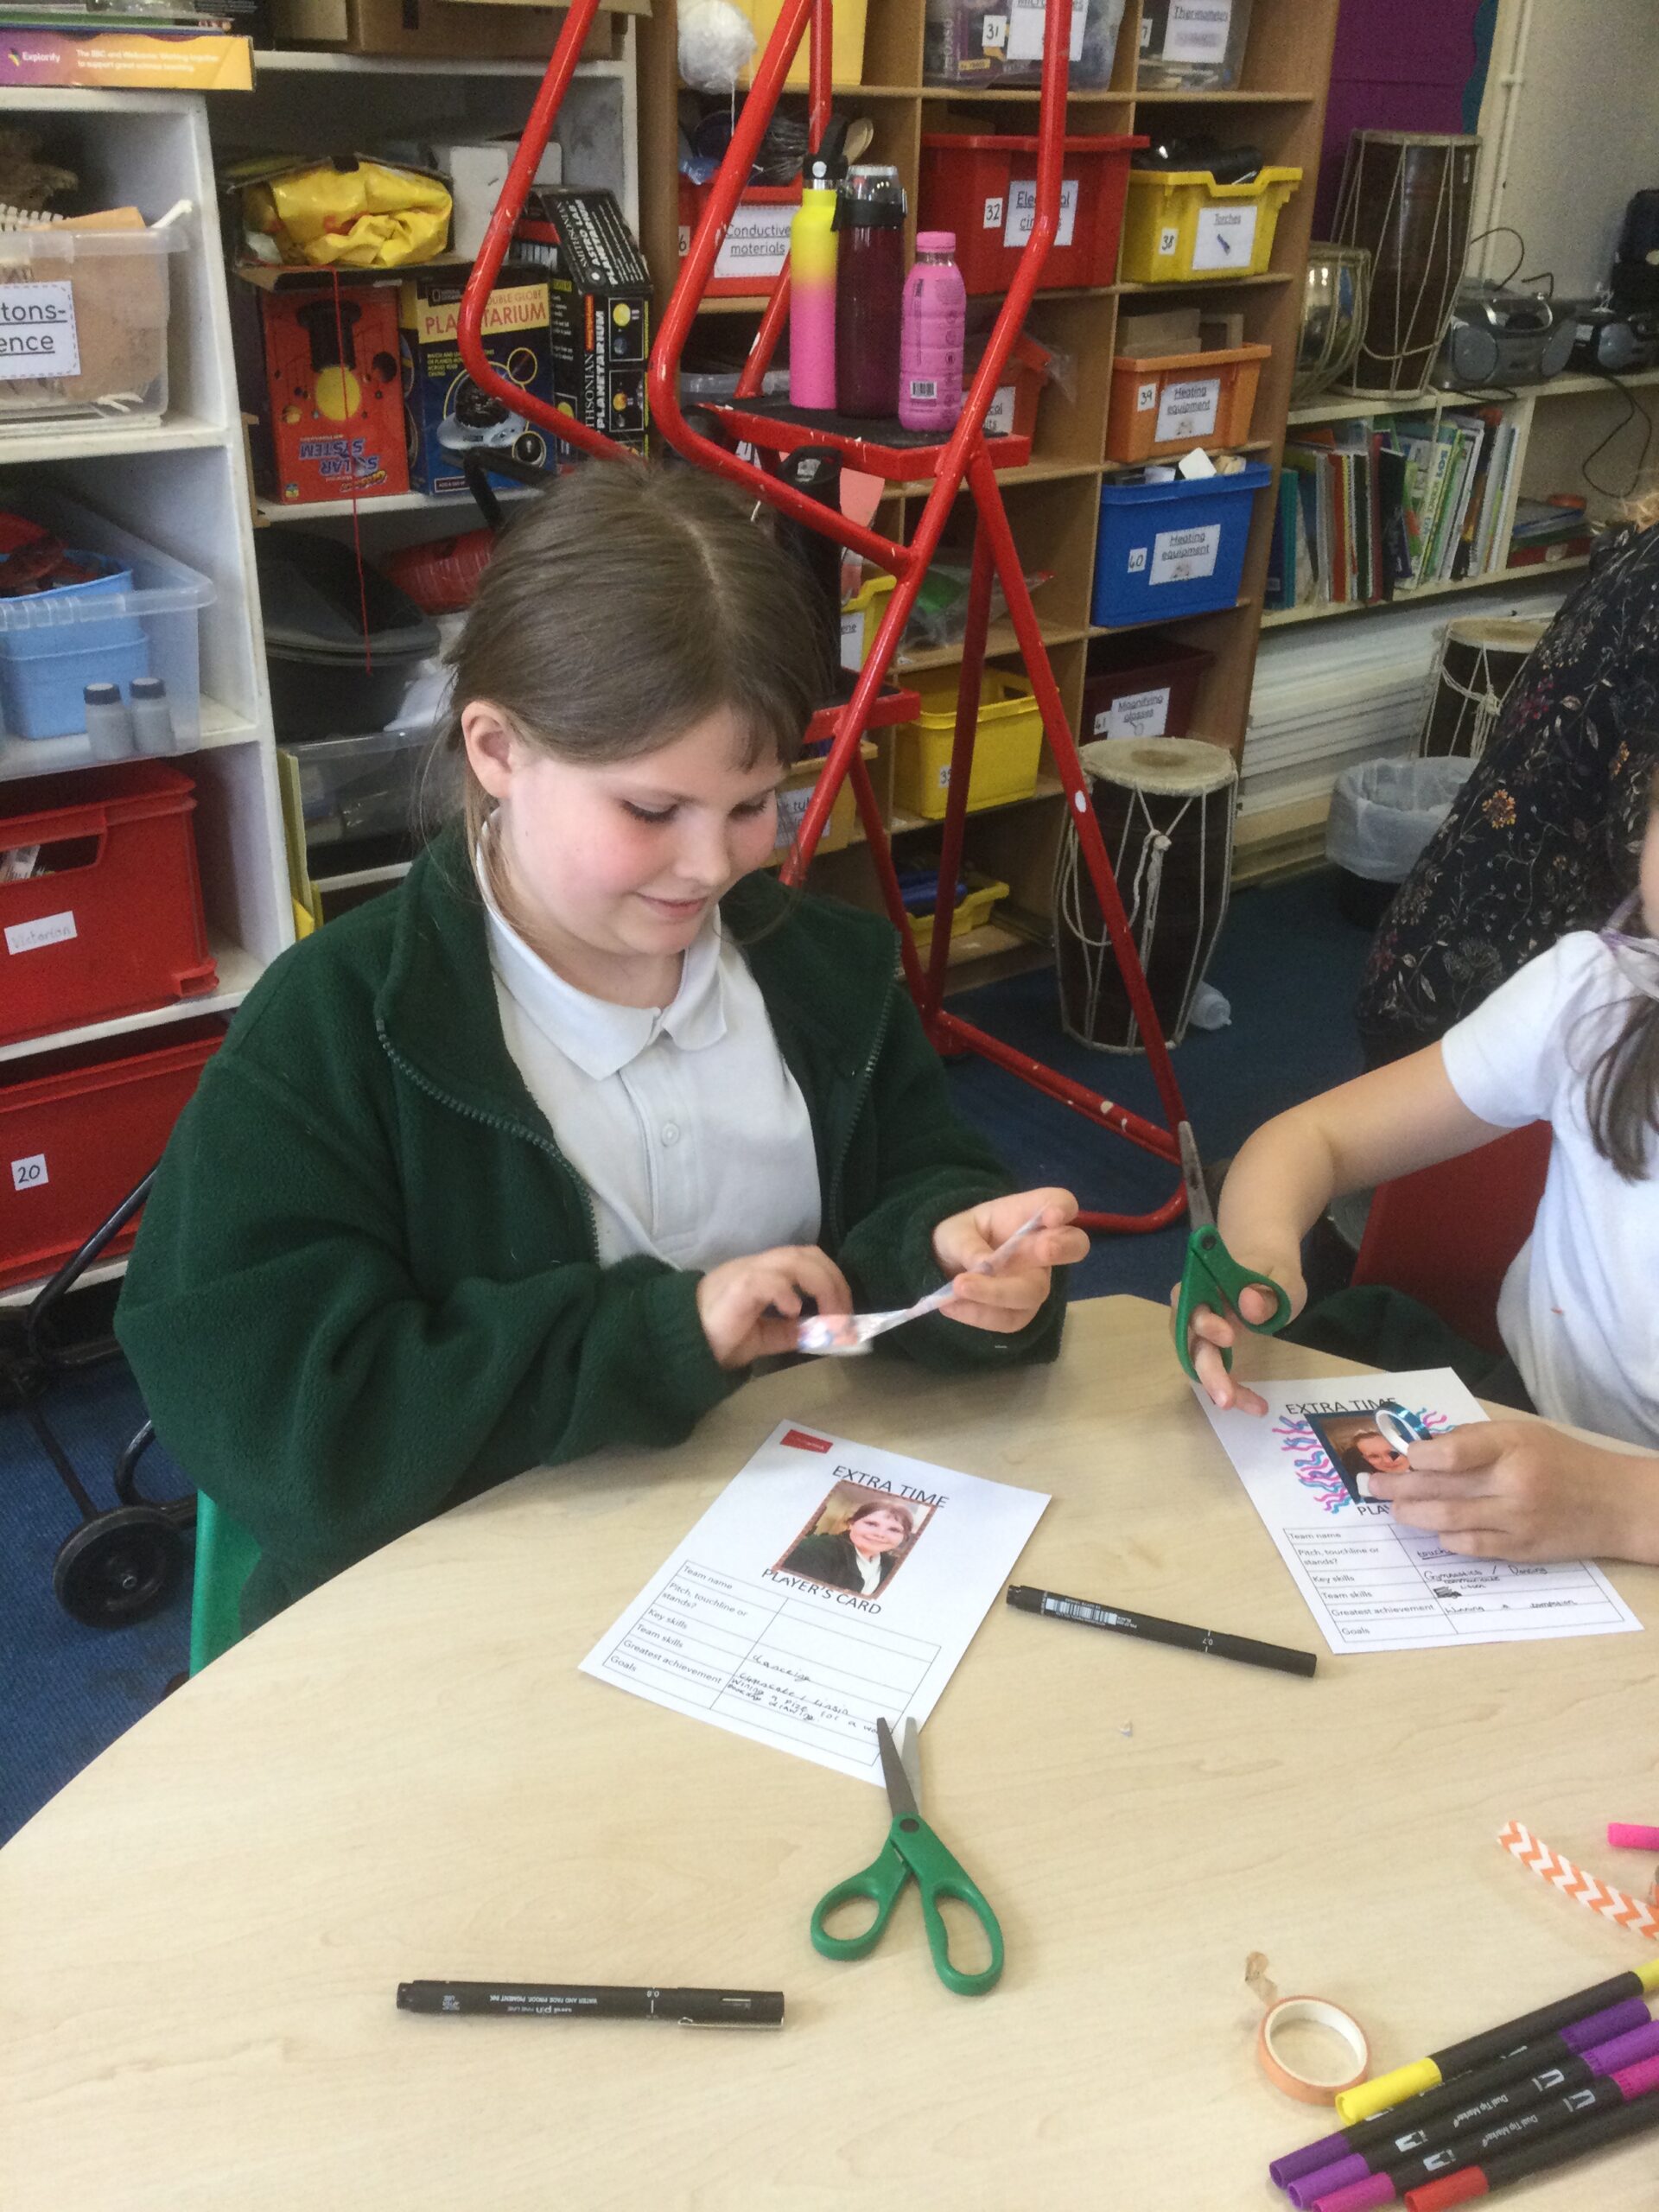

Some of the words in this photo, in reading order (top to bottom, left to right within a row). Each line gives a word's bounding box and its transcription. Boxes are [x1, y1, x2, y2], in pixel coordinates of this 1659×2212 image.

[986, 23, 999, 40] 31
[22, 52, 60, 63] Explorify
[986, 203, 1001, 220] 32
[1214, 213, 1242, 225] Torches
[730, 241, 785, 253] materials
[595, 310, 605, 429] PLANETARIUM
[1141, 390, 1153, 405] 39
[1174, 386, 1207, 400] Heating
[1167, 400, 1211, 416] equipment
[1170, 532, 1205, 546] Heating
[1161, 543, 1210, 561] equipment
[17, 1164, 41, 1184] 20
[1286, 1402, 1346, 1415] EXTRA
[832, 1465, 892, 1492] EXTRA
[900, 1484, 950, 1508] TIME
[683, 1566, 706, 1580] Team
[708, 1576, 733, 1590] name
[1313, 1575, 1331, 1584] Key
[662, 1592, 697, 1609] stands?
[694, 1592, 735, 1612] touchline
[836, 1593, 882, 1615] CARD
[1374, 1605, 1434, 1614] achievement
[647, 1608, 664, 1621] Key
[666, 1616, 688, 1630] skills
[637, 1624, 660, 1639] Team
[662, 1636, 683, 1649] skills
[1341, 1627, 1370, 1636] Goals
[610, 1655, 637, 1672] Goals
[623, 1639, 662, 1661] Greatest
[663, 1657, 722, 1684] achievement
[1480, 2101, 1494, 2113] Tip
[1492, 2094, 1509, 2107] Dual
[1457, 2107, 1481, 2122] Marker
[1522, 2114, 1538, 2127] Dual
[1486, 2127, 1510, 2141] Marker
[1510, 2121, 1523, 2133] Tip
